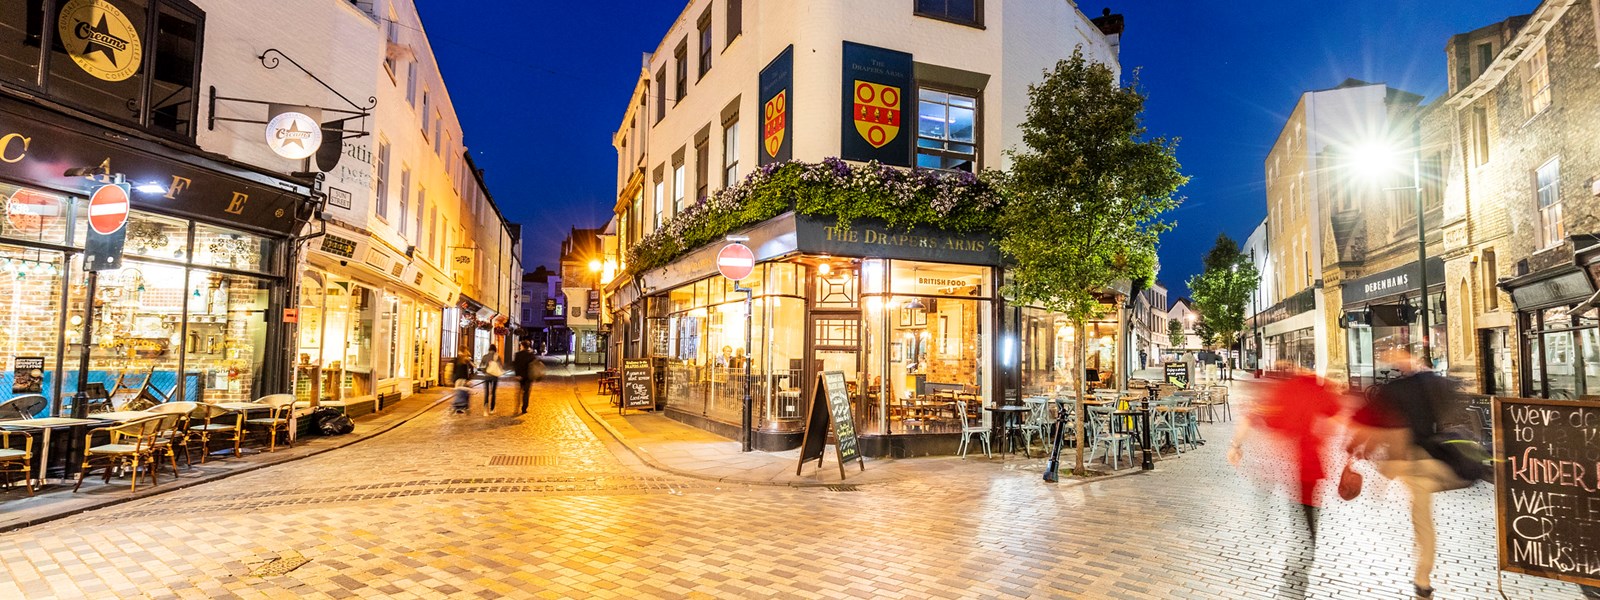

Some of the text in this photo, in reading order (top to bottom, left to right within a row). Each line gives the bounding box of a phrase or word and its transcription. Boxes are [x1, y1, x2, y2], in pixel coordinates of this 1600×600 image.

[74, 18, 129, 51] Creams
[864, 229, 937, 248] DRAPERS
[943, 237, 985, 251] ARMS
[1364, 274, 1409, 293] DEBENHAMS
[1506, 405, 1560, 426] We've
[1514, 424, 1534, 442] to
[1508, 447, 1596, 492] KINDER
